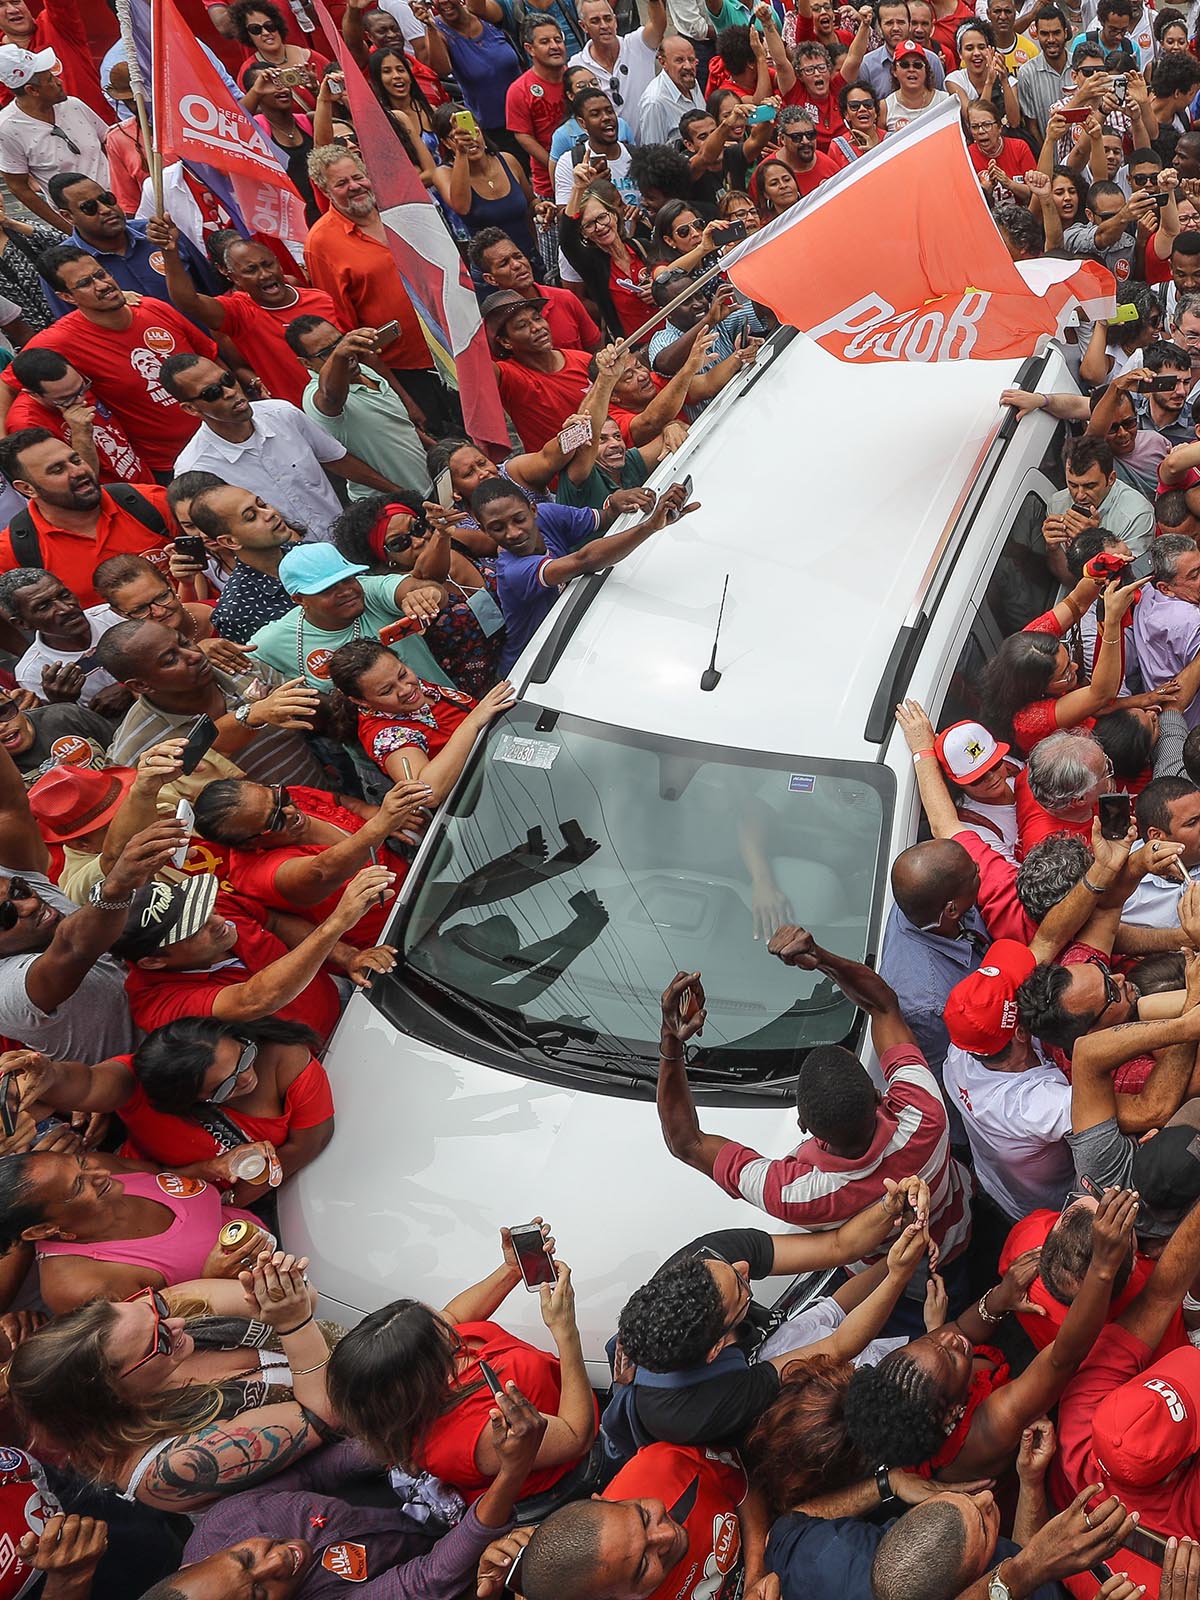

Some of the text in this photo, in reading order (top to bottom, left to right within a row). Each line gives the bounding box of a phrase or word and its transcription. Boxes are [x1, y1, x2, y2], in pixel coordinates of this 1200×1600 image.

[307, 650, 335, 669] LULA
[53, 737, 83, 758] LULA
[1005, 1001, 1018, 1029] LULA
[716, 1519, 736, 1564] LULA
[329, 1545, 349, 1575] LULA
